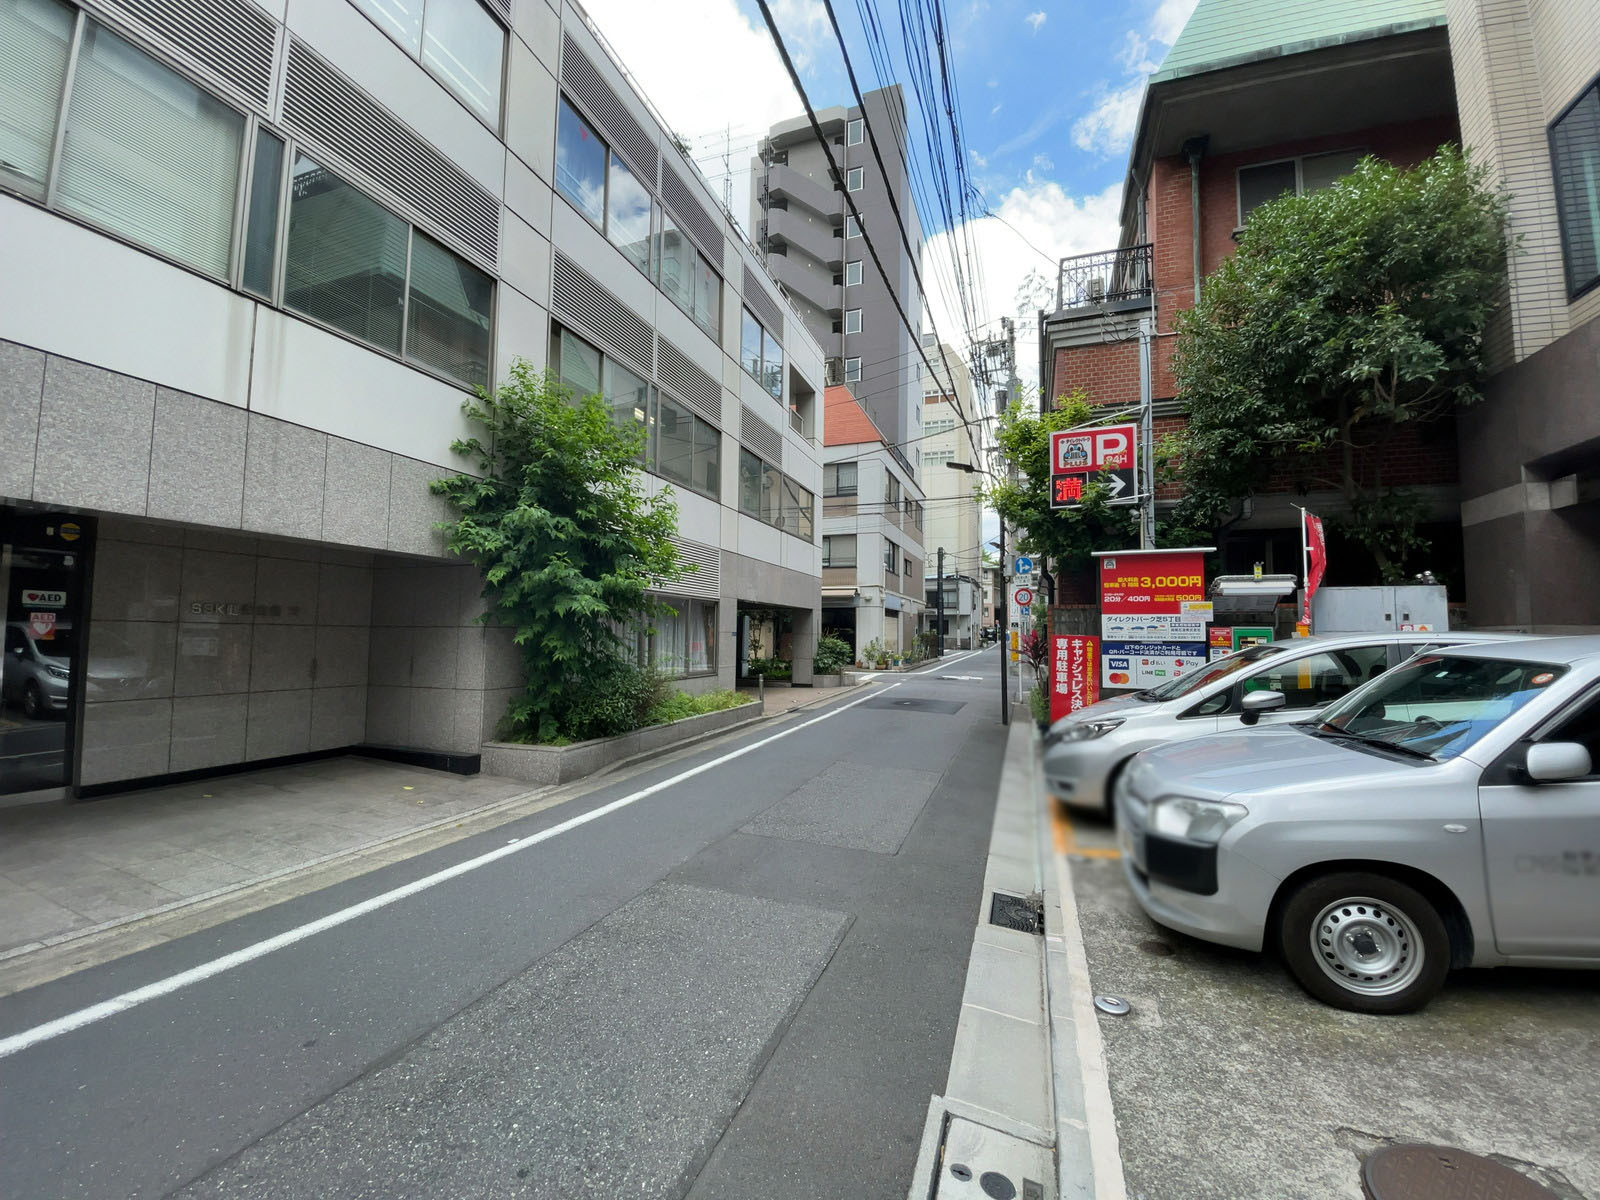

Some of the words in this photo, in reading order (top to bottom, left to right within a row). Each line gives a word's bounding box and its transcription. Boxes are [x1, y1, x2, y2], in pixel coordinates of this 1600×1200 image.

[1095, 433, 1128, 465] P
[1055, 477, 1083, 502] 満
[1140, 575, 1202, 589] 3,000円
[39, 593, 62, 602] AED
[1018, 593, 1029, 601] 20
[1055, 638, 1069, 694] 専用駐車場
[1110, 660, 1129, 668] VISA
[1185, 659, 1199, 667] Pay
